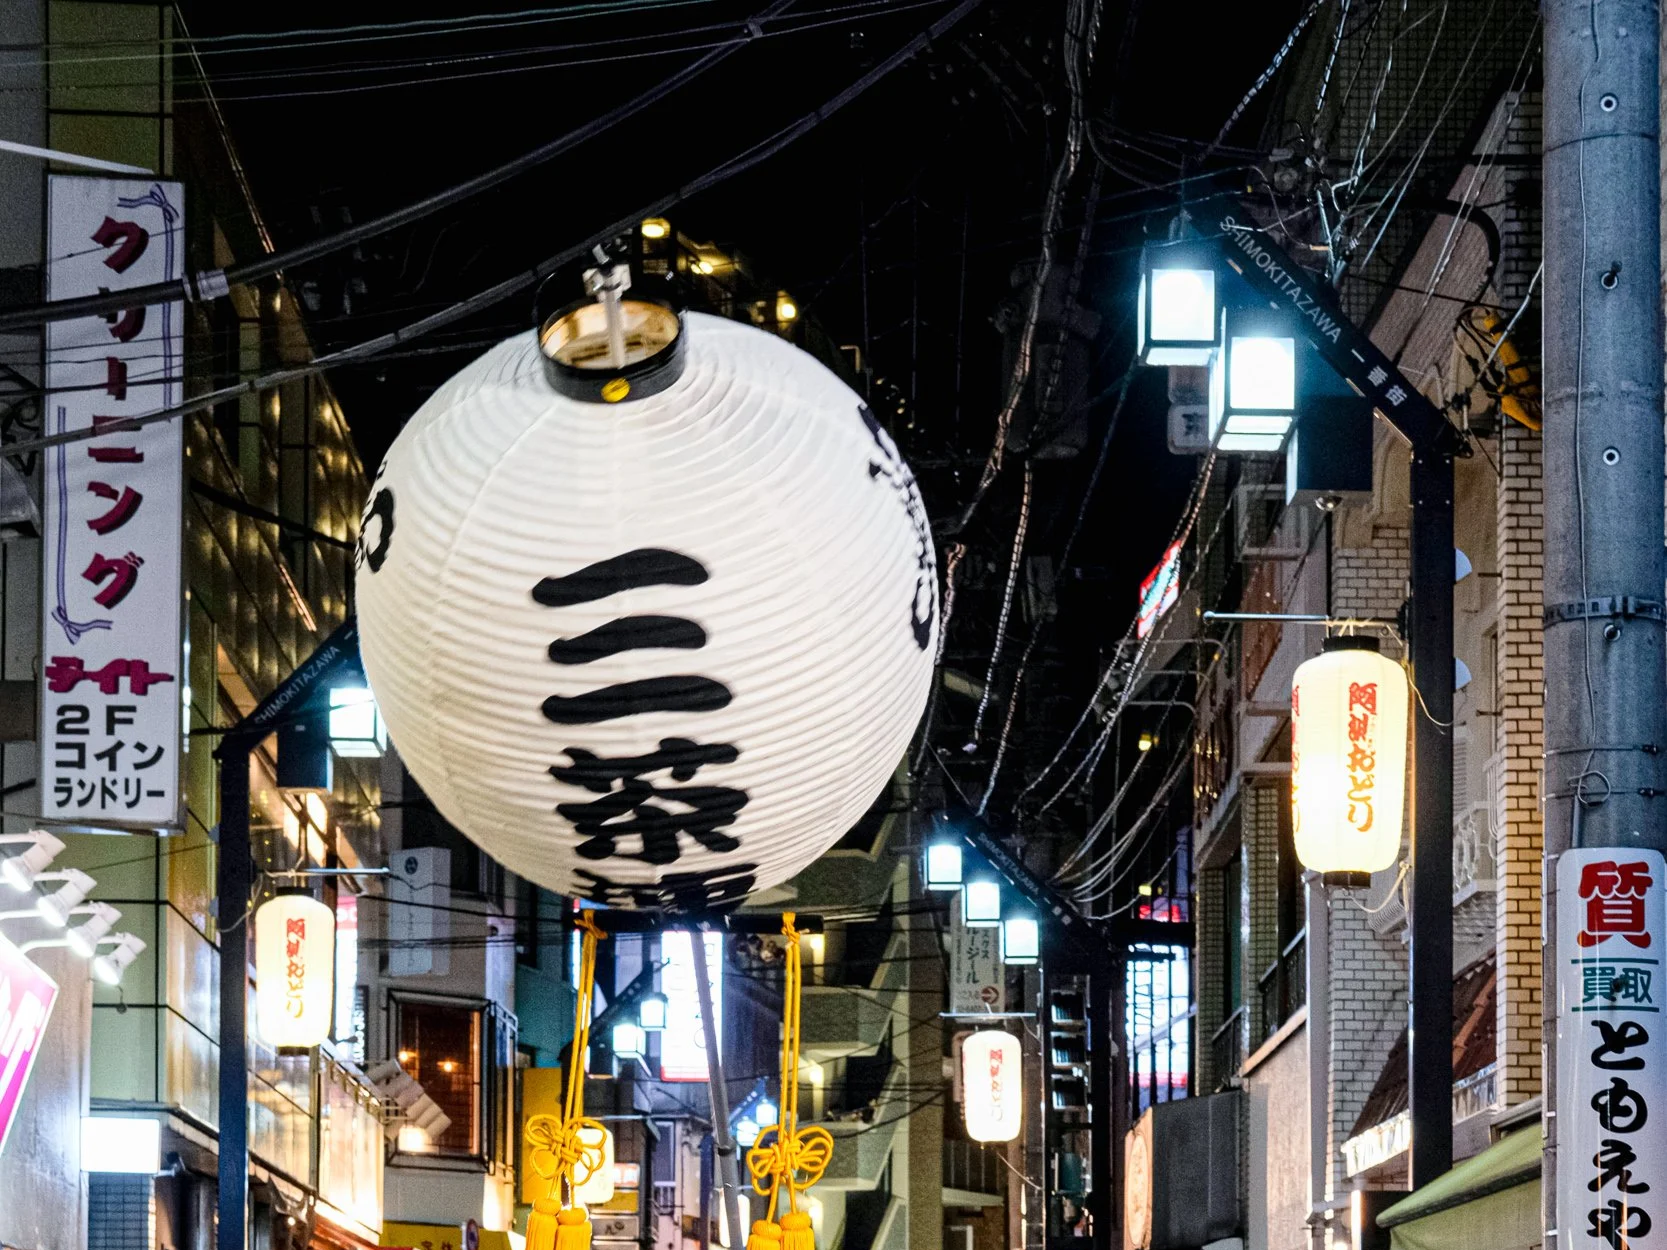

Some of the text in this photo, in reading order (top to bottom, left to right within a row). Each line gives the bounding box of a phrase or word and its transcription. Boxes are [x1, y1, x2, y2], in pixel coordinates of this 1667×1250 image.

[1219, 215, 1343, 344] SHIMOKITAZAWA
[1352, 348, 1408, 407] 一番街
[82, 215, 150, 610] クリーニング
[55, 740, 166, 772] コイン
[54, 776, 165, 810] ランドリー
[1577, 860, 1654, 950] 質
[1582, 966, 1653, 1004] 買取
